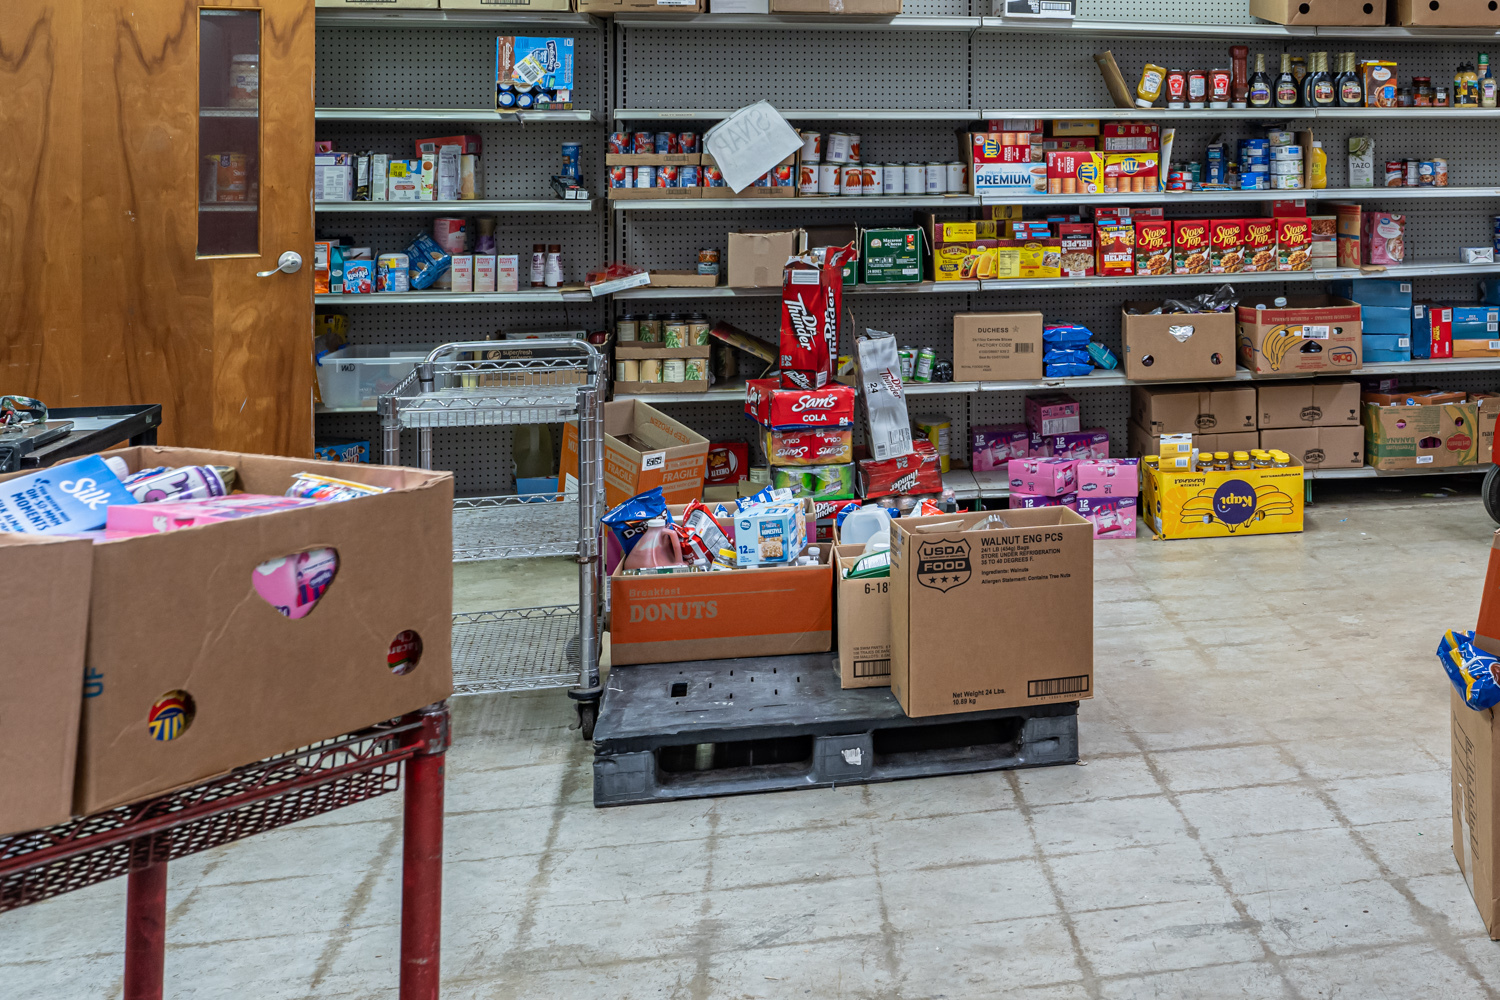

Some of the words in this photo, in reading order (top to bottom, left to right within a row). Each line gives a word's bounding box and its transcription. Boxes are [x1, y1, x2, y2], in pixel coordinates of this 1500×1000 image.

[984, 139, 997, 158] RITZ
[1121, 160, 1139, 171] RITZ
[1082, 162, 1096, 183] RITZ
[976, 174, 1031, 185] PREMIUM
[1139, 225, 1168, 245] Stove
[1177, 225, 1205, 245] Stove
[1213, 225, 1240, 245] Stove
[1245, 224, 1273, 243] Stove
[1280, 222, 1308, 242] Stove
[1290, 232, 1305, 245] Top
[1150, 236, 1164, 249] Top
[1187, 235, 1201, 247] Top
[1223, 234, 1237, 246] Top
[1254, 234, 1269, 245] Top
[1104, 254, 1131, 262] HELPER
[792, 395, 838, 412] Sam's
[976, 435, 984, 443] 12
[1056, 437, 1065, 445] 12
[607, 462, 633, 483] FRAGILE
[663, 468, 698, 482] FRAGILE
[59, 478, 112, 510] Silk
[1080, 500, 1089, 508] 12
[11, 492, 51, 531] MOMENTS
[981, 535, 1021, 547] WALNUT
[1022, 534, 1043, 543] ENG
[1045, 532, 1063, 542] PCS
[738, 545, 748, 554] 12
[924, 546, 965, 556] USDA
[1019, 548, 1061, 557] REFRIGERATION
[923, 561, 966, 571] FOOD
[629, 587, 681, 598] Breakfast
[629, 600, 718, 623] DONUTS
[964, 690, 984, 698] Weight
